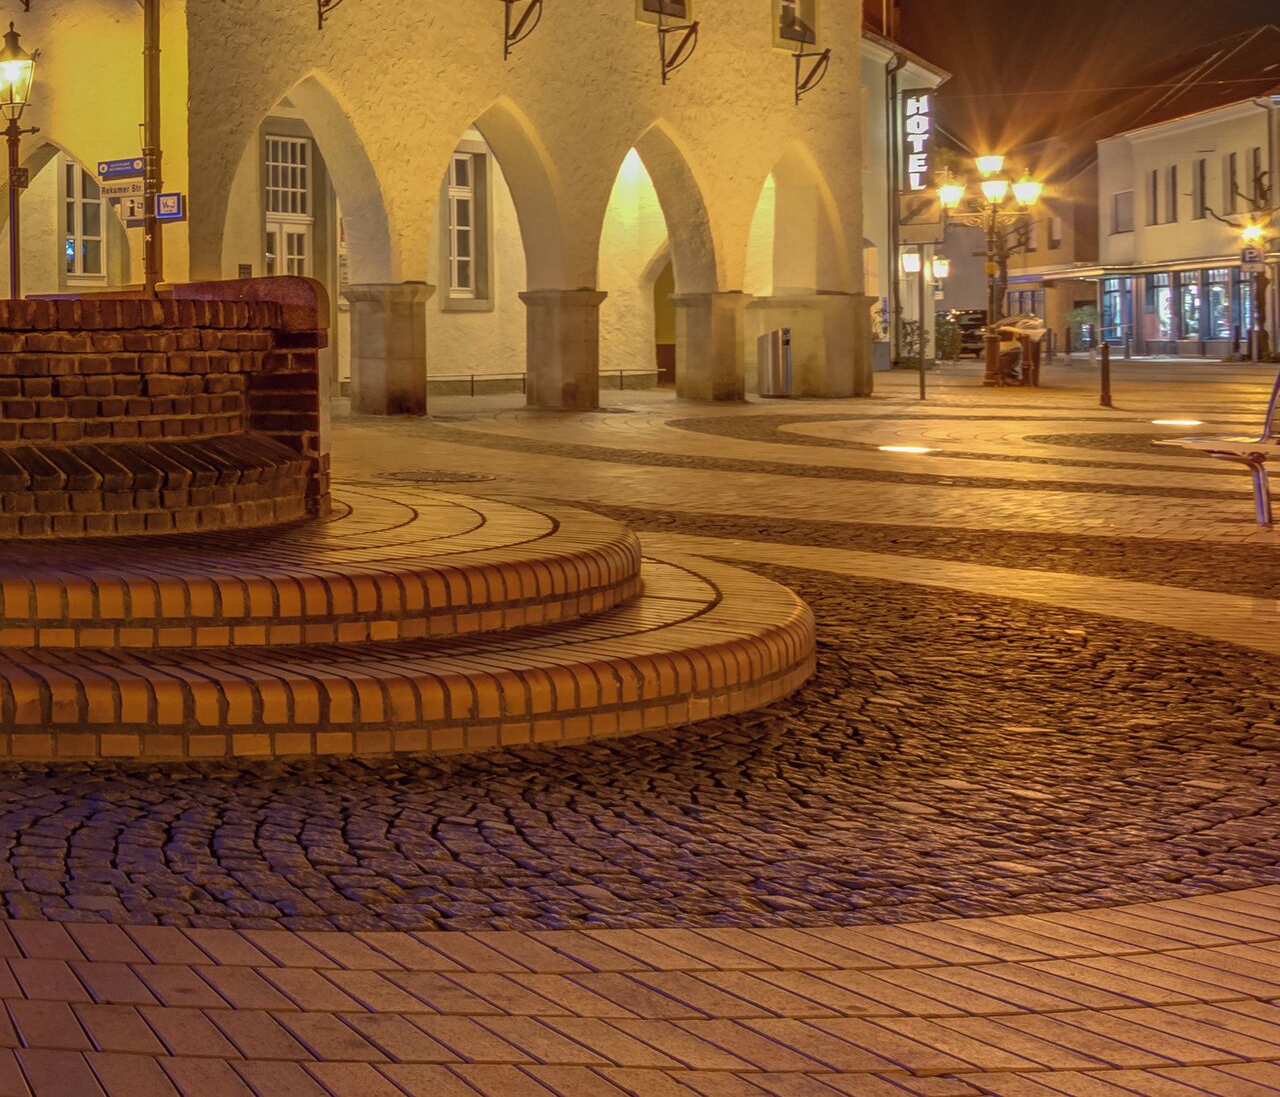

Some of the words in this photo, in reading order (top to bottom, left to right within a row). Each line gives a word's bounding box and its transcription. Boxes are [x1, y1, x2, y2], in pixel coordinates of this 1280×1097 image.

[906, 95, 930, 191] HOTEL
[101, 187, 130, 195] Rekumer
[131, 184, 143, 193] Str.
